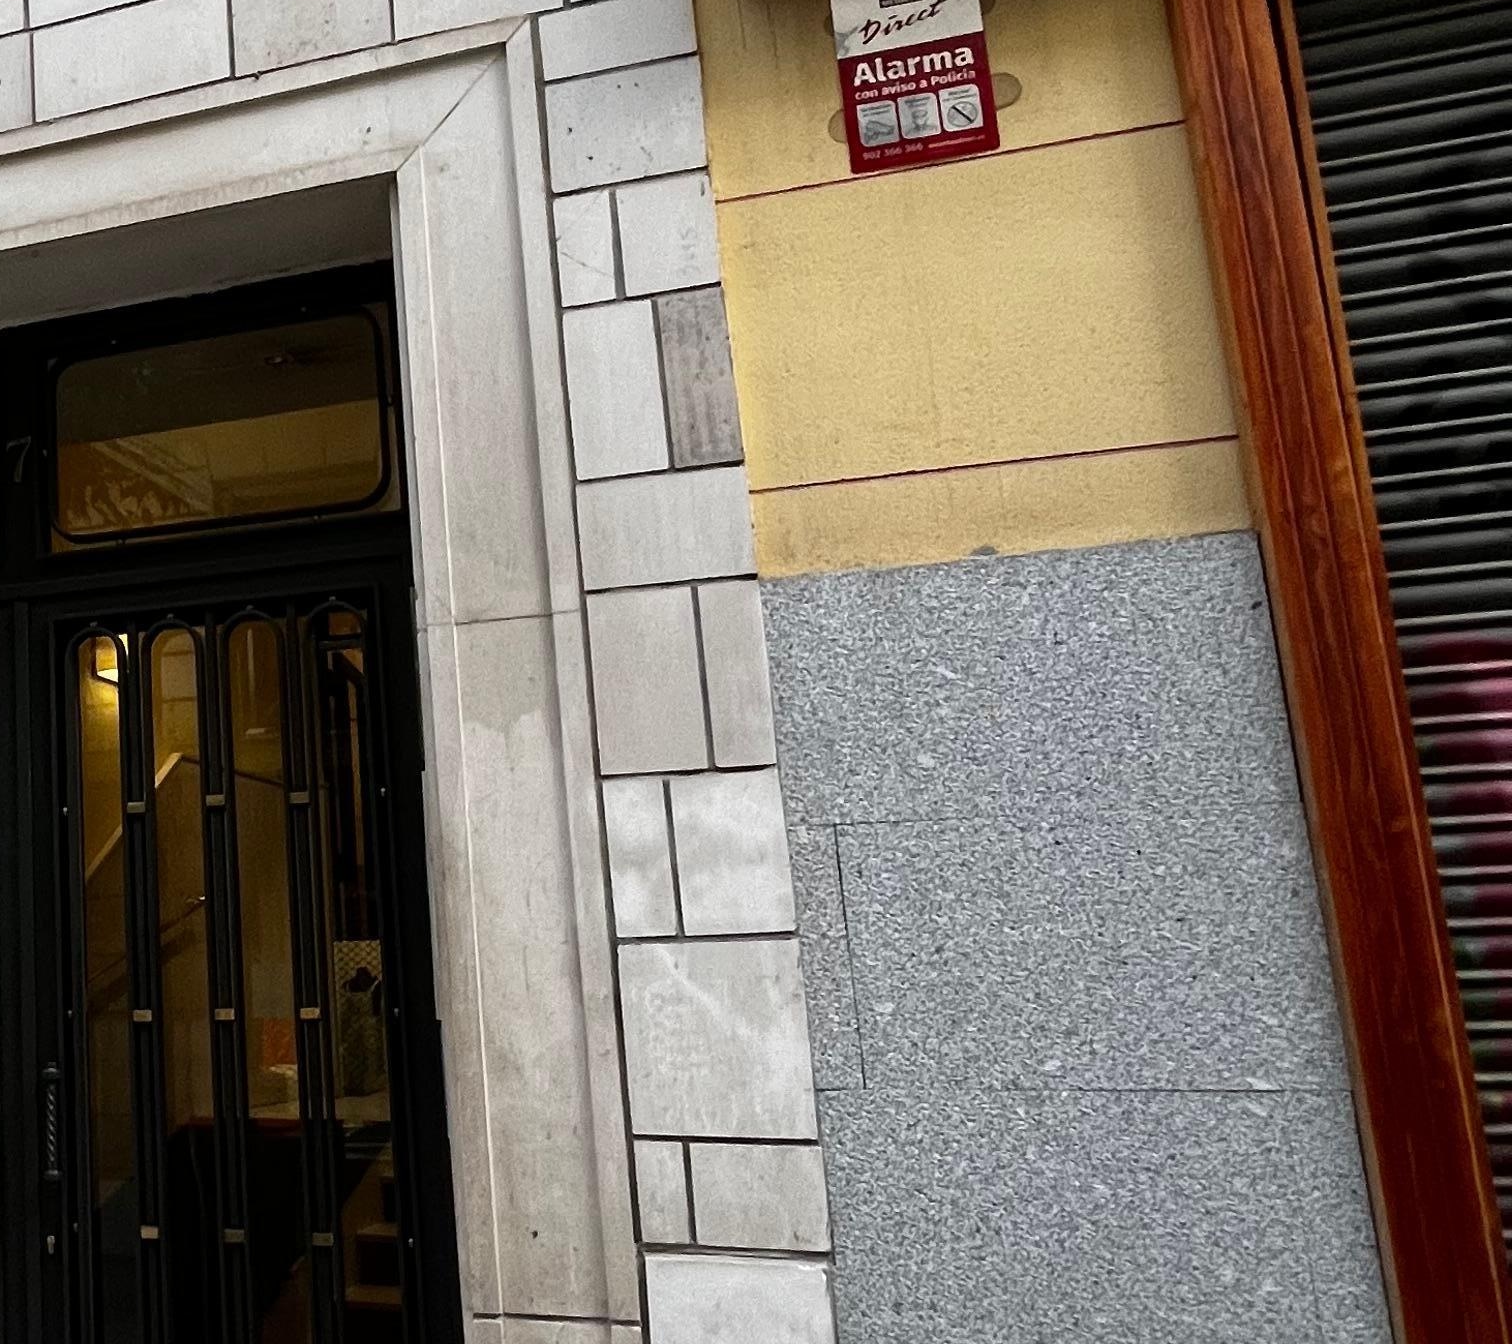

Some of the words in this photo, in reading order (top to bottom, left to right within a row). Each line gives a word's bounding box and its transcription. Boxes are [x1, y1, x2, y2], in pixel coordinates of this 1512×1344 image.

[853, 46, 975, 87] Alarma
[854, 89, 879, 101] con
[881, 81, 917, 97] aviso
[918, 79, 928, 89] a
[5, 434, 33, 483] 7
